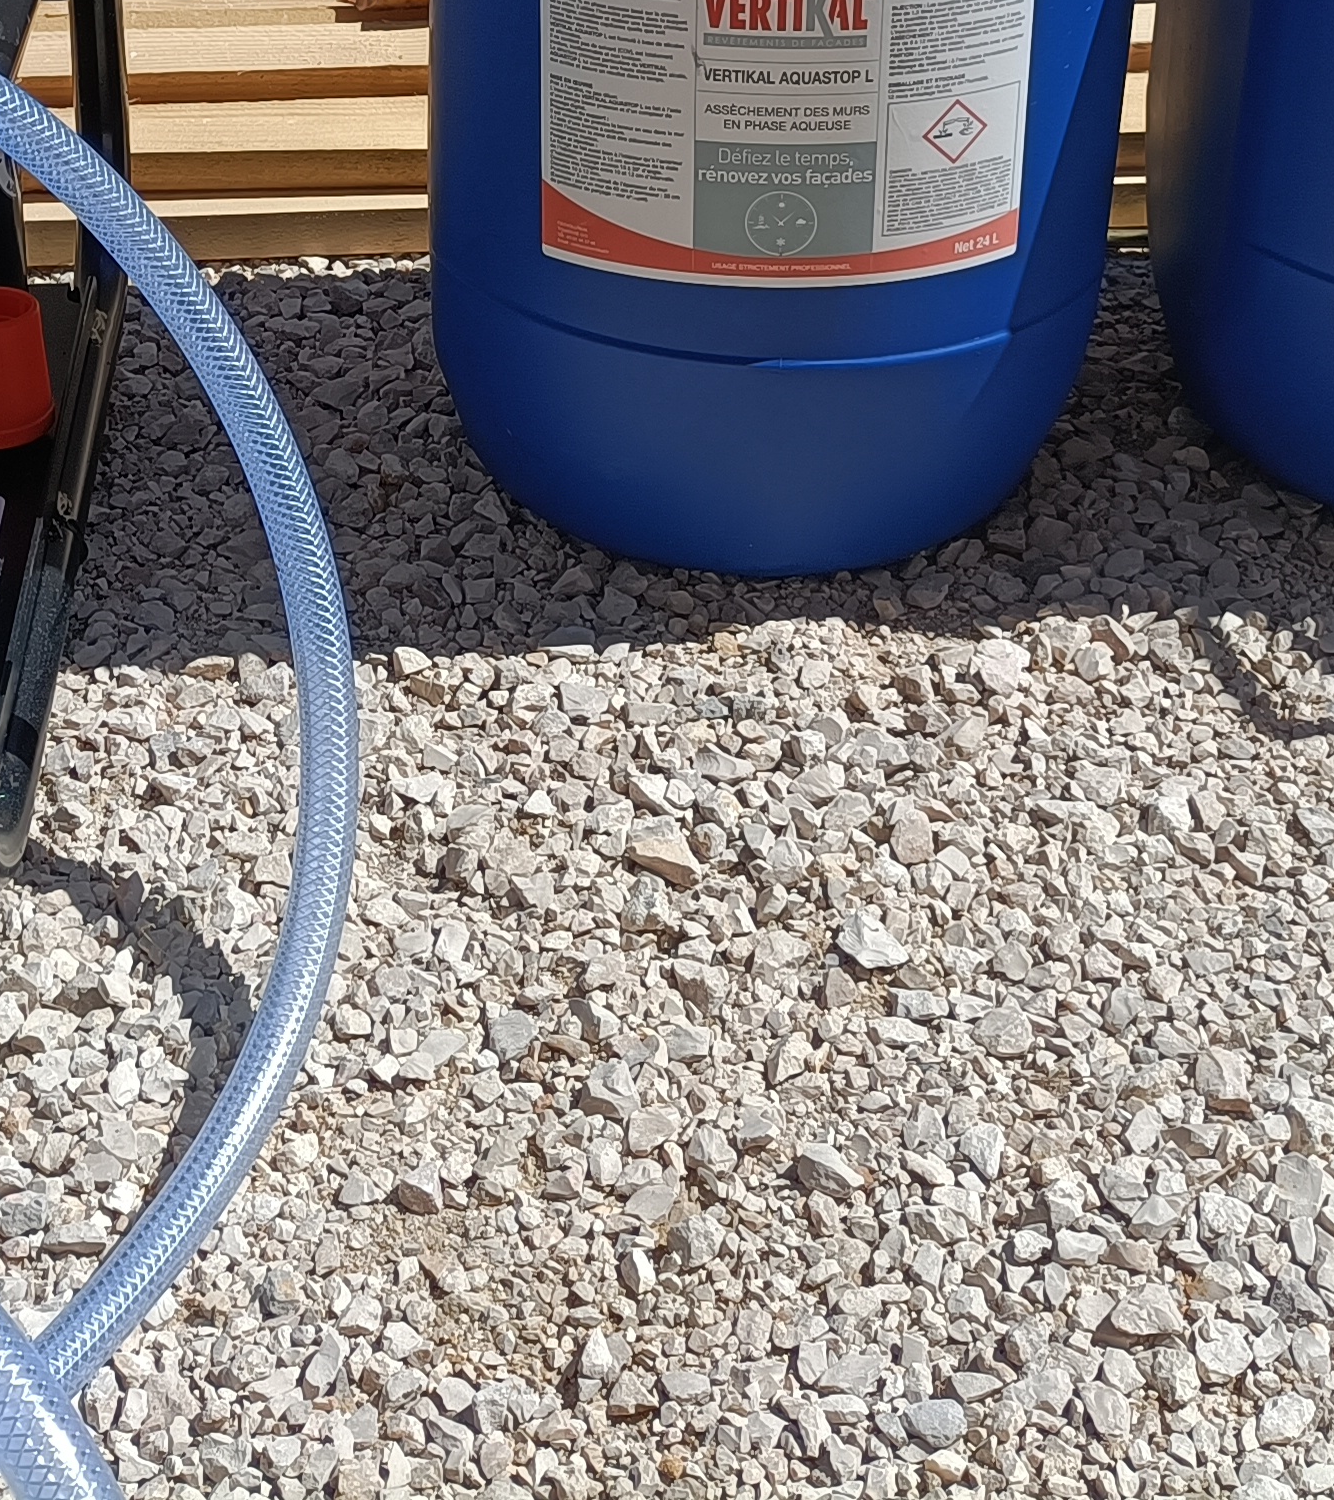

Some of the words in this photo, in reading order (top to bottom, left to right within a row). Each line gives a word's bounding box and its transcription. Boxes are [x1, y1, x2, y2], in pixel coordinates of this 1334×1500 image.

[791, 38, 806, 48] DE
[704, 68, 775, 85] VERTIKAL
[779, 70, 861, 86] AQUASTOP
[865, 69, 874, 83] L
[704, 103, 801, 118] ASSÈCHEMENT
[803, 106, 830, 117] DES
[832, 104, 870, 117] MURS
[723, 119, 741, 130] EN
[744, 119, 787, 132] PHASE
[790, 120, 852, 132] AQUEUSE
[718, 147, 771, 165] Défiez
[775, 150, 791, 166] le
[795, 151, 854, 169] temps,
[698, 165, 768, 184] rénovez
[771, 171, 802, 185] vos
[805, 167, 873, 188] façades
[954, 239, 975, 255] Net
[976, 235, 991, 249] 24
[992, 232, 999, 244] L
